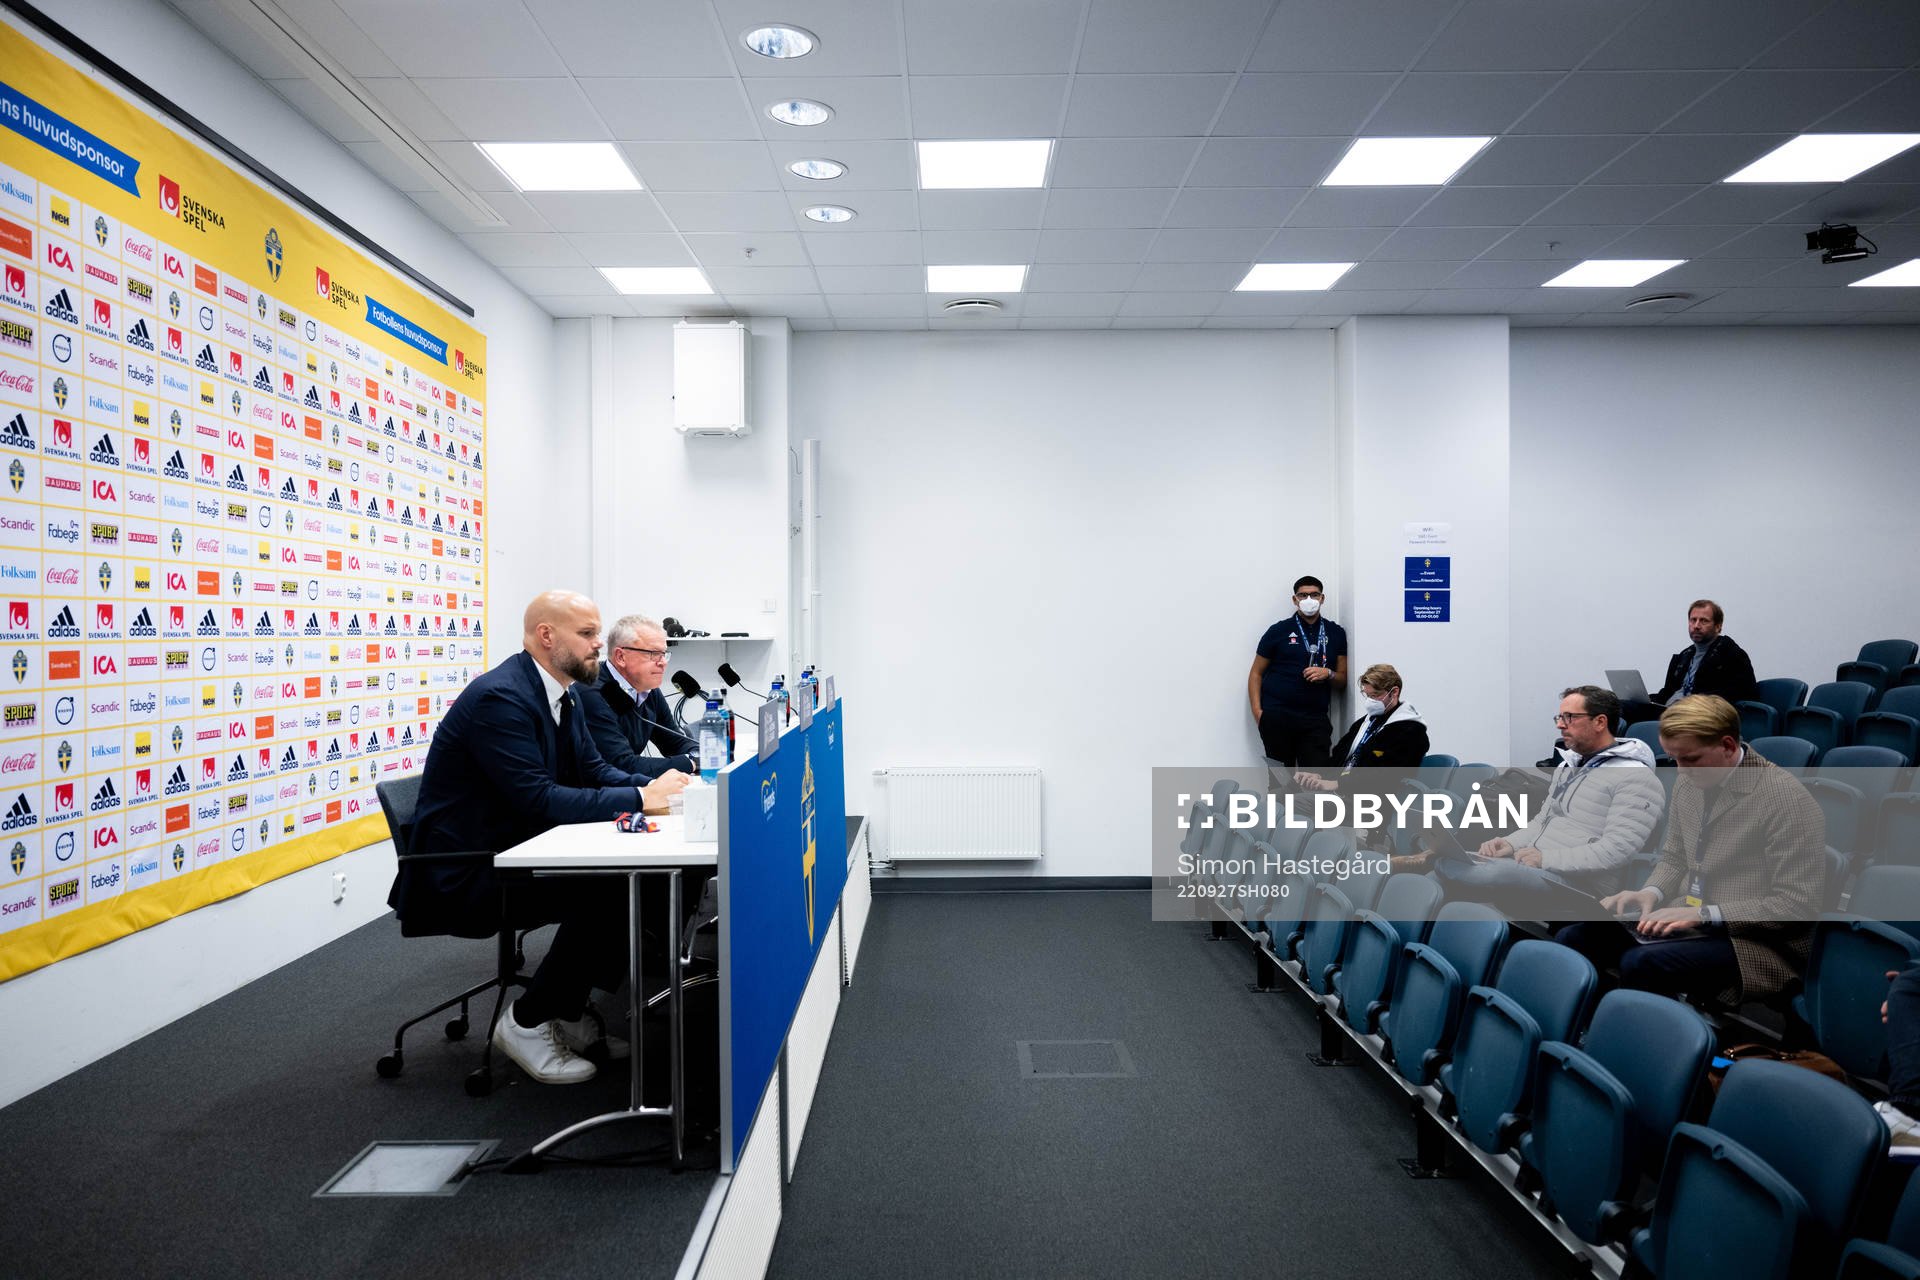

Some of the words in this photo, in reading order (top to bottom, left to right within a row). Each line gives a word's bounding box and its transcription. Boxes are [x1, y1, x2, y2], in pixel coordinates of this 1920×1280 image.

[0, 97, 19, 120] ns
[24, 105, 124, 178] huvudsponsor
[0, 181, 32, 205] olksam
[183, 195, 225, 229] SVENSKA
[183, 210, 206, 233] SPEL
[48, 244, 74, 272] ICA
[164, 253, 184, 278] ICA
[85, 264, 118, 285] BAUHAUS
[127, 277, 152, 298] SPORT
[331, 281, 360, 305] SVENSKA
[23, 299, 36, 312] SPEL
[332, 293, 347, 310] SPEL
[45, 305, 78, 325] adidas
[0, 319, 33, 341] SPORT
[86, 324, 107, 336] SVENSKA
[108, 330, 120, 341] SPEL
[225, 323, 246, 339] Scandic
[373, 306, 404, 334] Fotbollens
[404, 324, 442, 355] huvudsponsor
[127, 333, 154, 351] adidas
[253, 334, 272, 354] Fabege
[89, 353, 118, 370] Scandic
[161, 350, 179, 361] SVENSKA
[195, 359, 219, 374] adidas
[465, 359, 483, 375] SVENSKA
[127, 364, 154, 386] Fabege
[465, 369, 475, 380] SPEL
[163, 374, 189, 392] Folksam
[253, 380, 273, 393] adidas
[384, 389, 395, 405] ICA
[432, 385, 441, 401] ICA
[89, 395, 118, 414] Folksam
[304, 398, 322, 410] adidas
[281, 412, 296, 430] ICA
[0, 433, 35, 450] adidas
[228, 430, 245, 450] ICA
[44, 447, 68, 458] SVENSKA
[90, 451, 120, 466] adidas
[163, 466, 189, 480] adidas
[45, 477, 80, 491] BAUHAUS
[93, 480, 117, 502] ICA
[226, 480, 248, 491] adidas
[129, 491, 155, 503] Scandic
[280, 491, 298, 502] adidas
[198, 501, 219, 518] Fabege
[460, 499, 469, 511] ICA
[0, 517, 35, 531] Scandic
[48, 523, 79, 543] Fabege
[92, 524, 118, 540] SPORT
[128, 532, 157, 544] BAUHAUS
[282, 547, 297, 564] ICA
[348, 556, 361, 571] ICA
[402, 563, 413, 577] ICA
[1, 565, 36, 579] Folksam
[167, 572, 187, 591] ICA
[433, 594, 442, 606] ICA
[48, 626, 80, 637] adidas
[129, 626, 156, 637] adidas
[197, 626, 220, 636] adidas
[166, 652, 189, 664] SPORT
[227, 652, 249, 662] Scandic
[385, 646, 397, 660] ICA
[93, 655, 117, 675] ICA
[128, 657, 157, 666] BAUHAUS
[282, 683, 297, 698] ICA
[4, 704, 36, 722] SPORT
[91, 701, 120, 714] Scandic
[130, 699, 156, 713] Fabege
[229, 722, 246, 739] ICA
[91, 745, 120, 757] Folksam
[326, 751, 342, 762] adidas
[280, 760, 298, 771] adidas
[402, 756, 413, 770] ICA
[227, 771, 249, 782] adidas
[164, 783, 190, 795] adidas
[90, 796, 121, 811] adidas
[128, 797, 148, 806] SVENSKA
[347, 800, 360, 815] ICA
[45, 814, 70, 824] SVENSKA
[71, 811, 84, 820] SPEL
[198, 807, 220, 820] Fabege
[1, 814, 37, 831] adidas
[130, 820, 157, 835] Scandic
[94, 827, 118, 848] ICA
[131, 861, 158, 876] Folksam
[91, 872, 120, 889] Fabege
[50, 879, 79, 901] SPORT
[2, 896, 36, 916] Scandic
